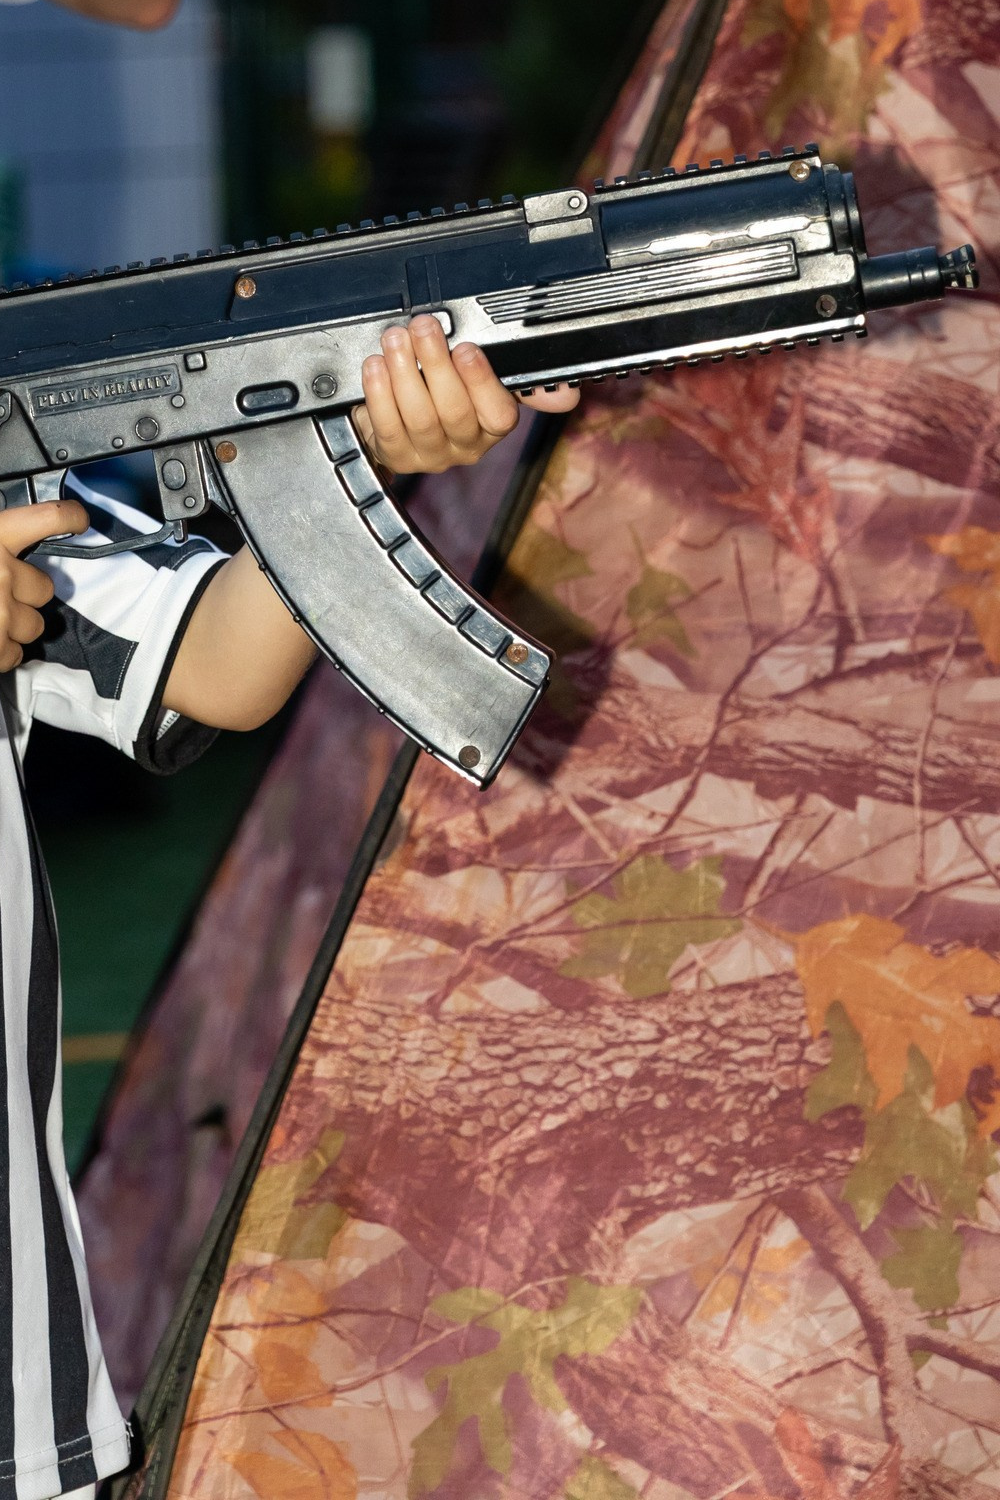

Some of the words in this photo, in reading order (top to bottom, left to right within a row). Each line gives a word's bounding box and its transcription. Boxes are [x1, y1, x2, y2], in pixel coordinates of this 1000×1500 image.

[36, 390, 77, 408] PLAY
[81, 386, 101, 401] IN
[104, 373, 172, 397] REALITY
